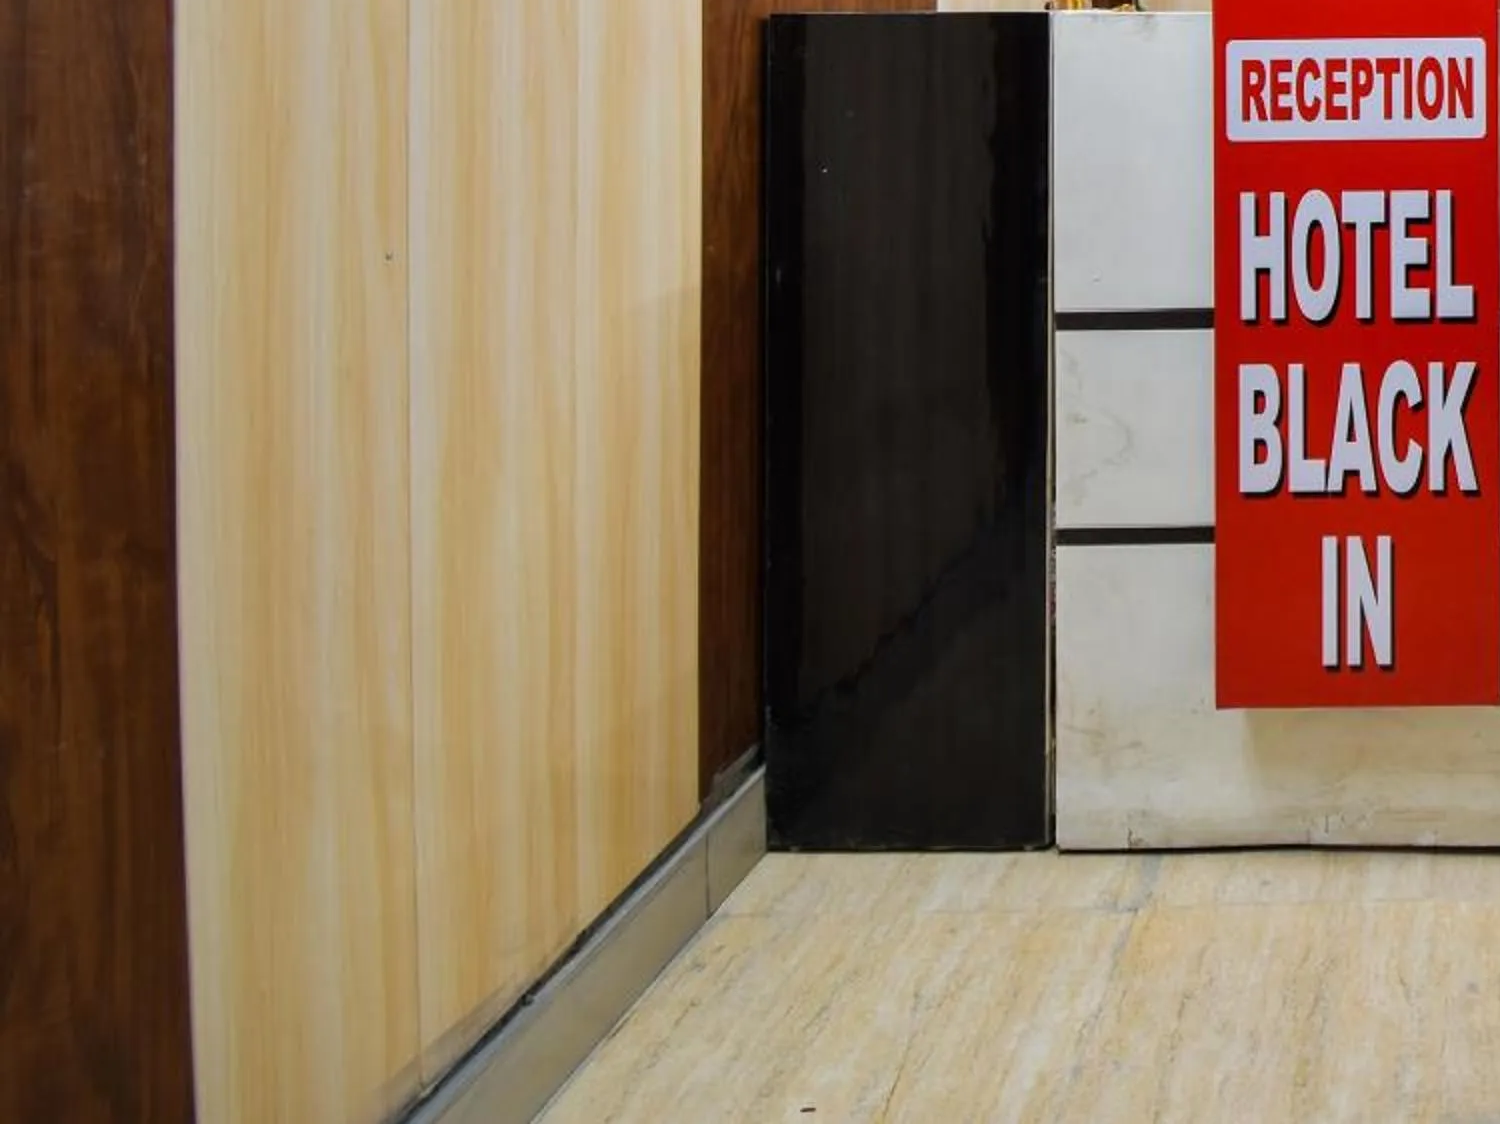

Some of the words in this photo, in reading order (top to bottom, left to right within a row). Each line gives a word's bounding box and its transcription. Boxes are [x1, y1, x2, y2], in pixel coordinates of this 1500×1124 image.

[1242, 57, 1474, 121] RECEPTION
[1241, 190, 1472, 320] HOTEL
[1240, 361, 1476, 492] BLACK
[1323, 536, 1390, 664] IN
